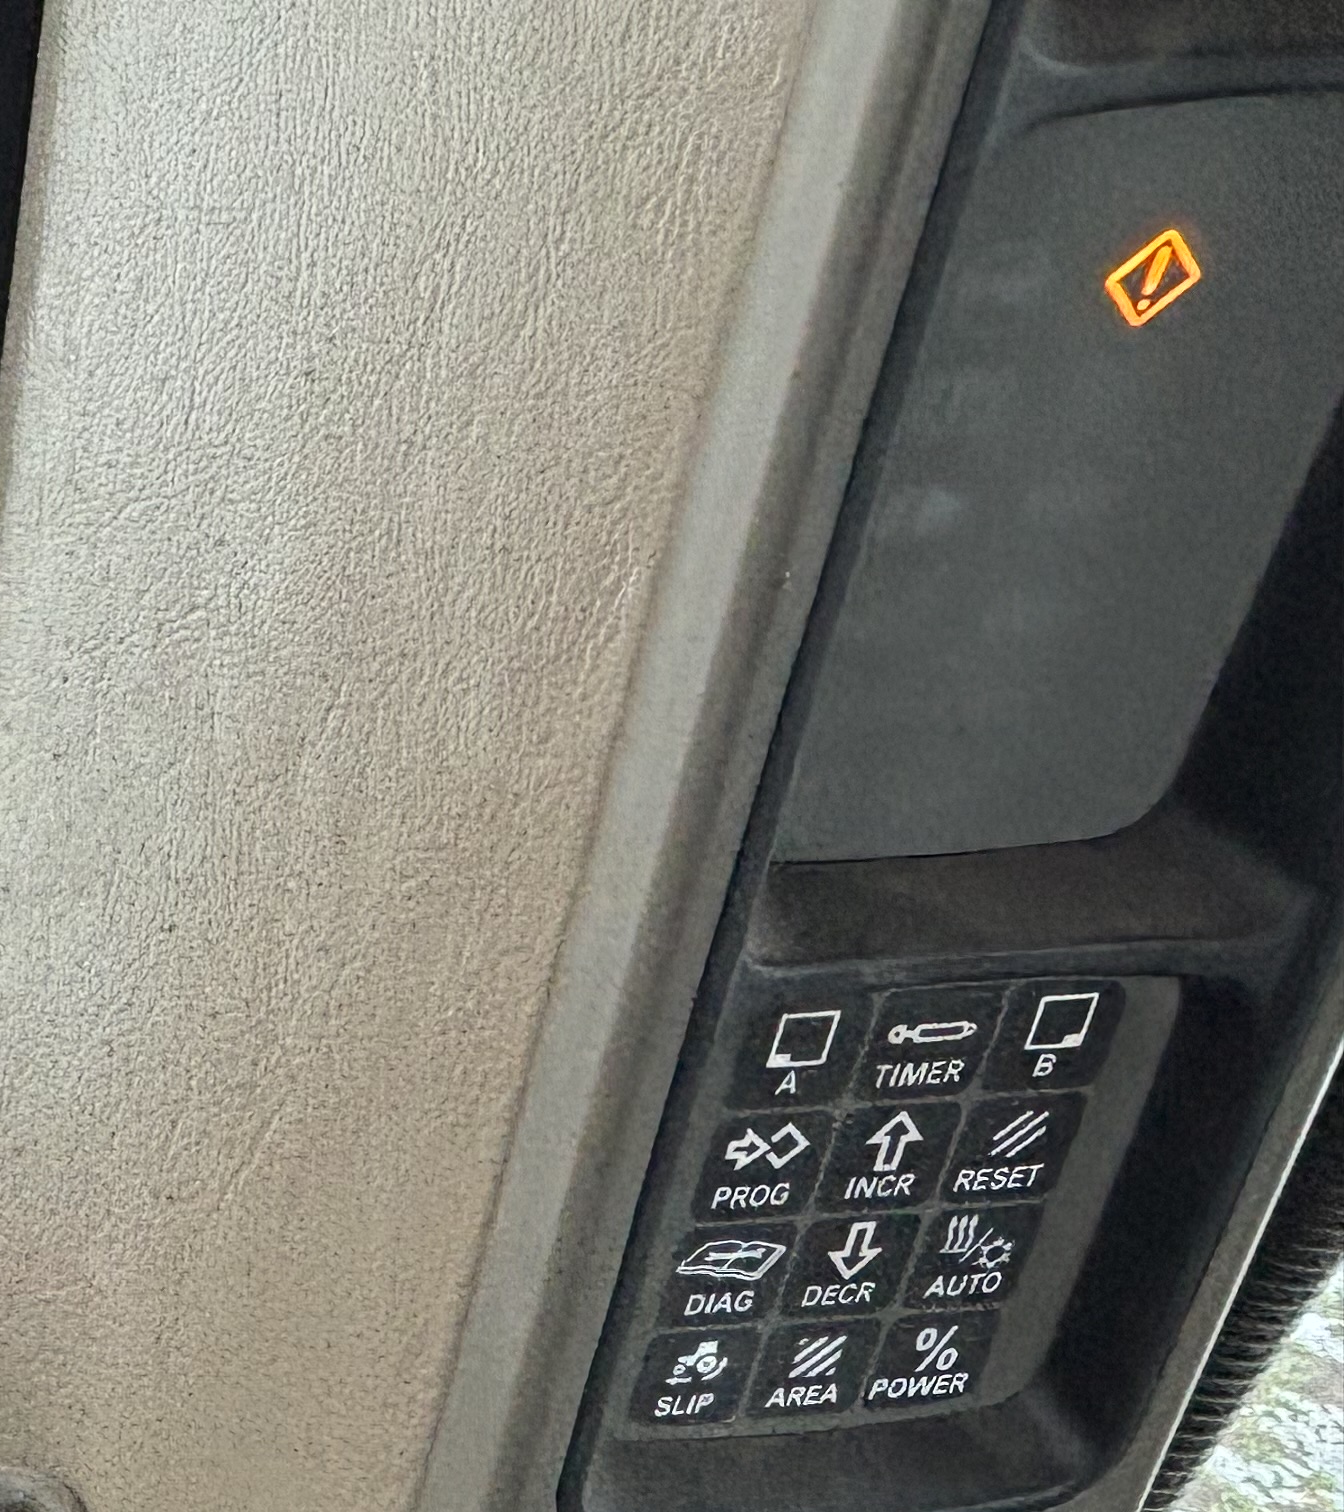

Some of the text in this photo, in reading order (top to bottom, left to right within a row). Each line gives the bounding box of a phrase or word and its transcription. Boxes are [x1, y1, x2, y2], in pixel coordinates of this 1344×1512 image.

[875, 1059, 965, 1089] TIMER
[1032, 1053, 1055, 1078] B
[775, 1071, 798, 1095] A
[844, 1174, 916, 1200] INCR
[953, 1164, 1043, 1192] RESET
[711, 1182, 789, 1210] PROG
[801, 1282, 875, 1307] DECR
[925, 1271, 1002, 1297] AUTO
[683, 1290, 755, 1317] DIAG
[765, 1382, 838, 1409] AREA
[869, 1373, 967, 1399] POWER
[655, 1393, 715, 1418] SLIP
